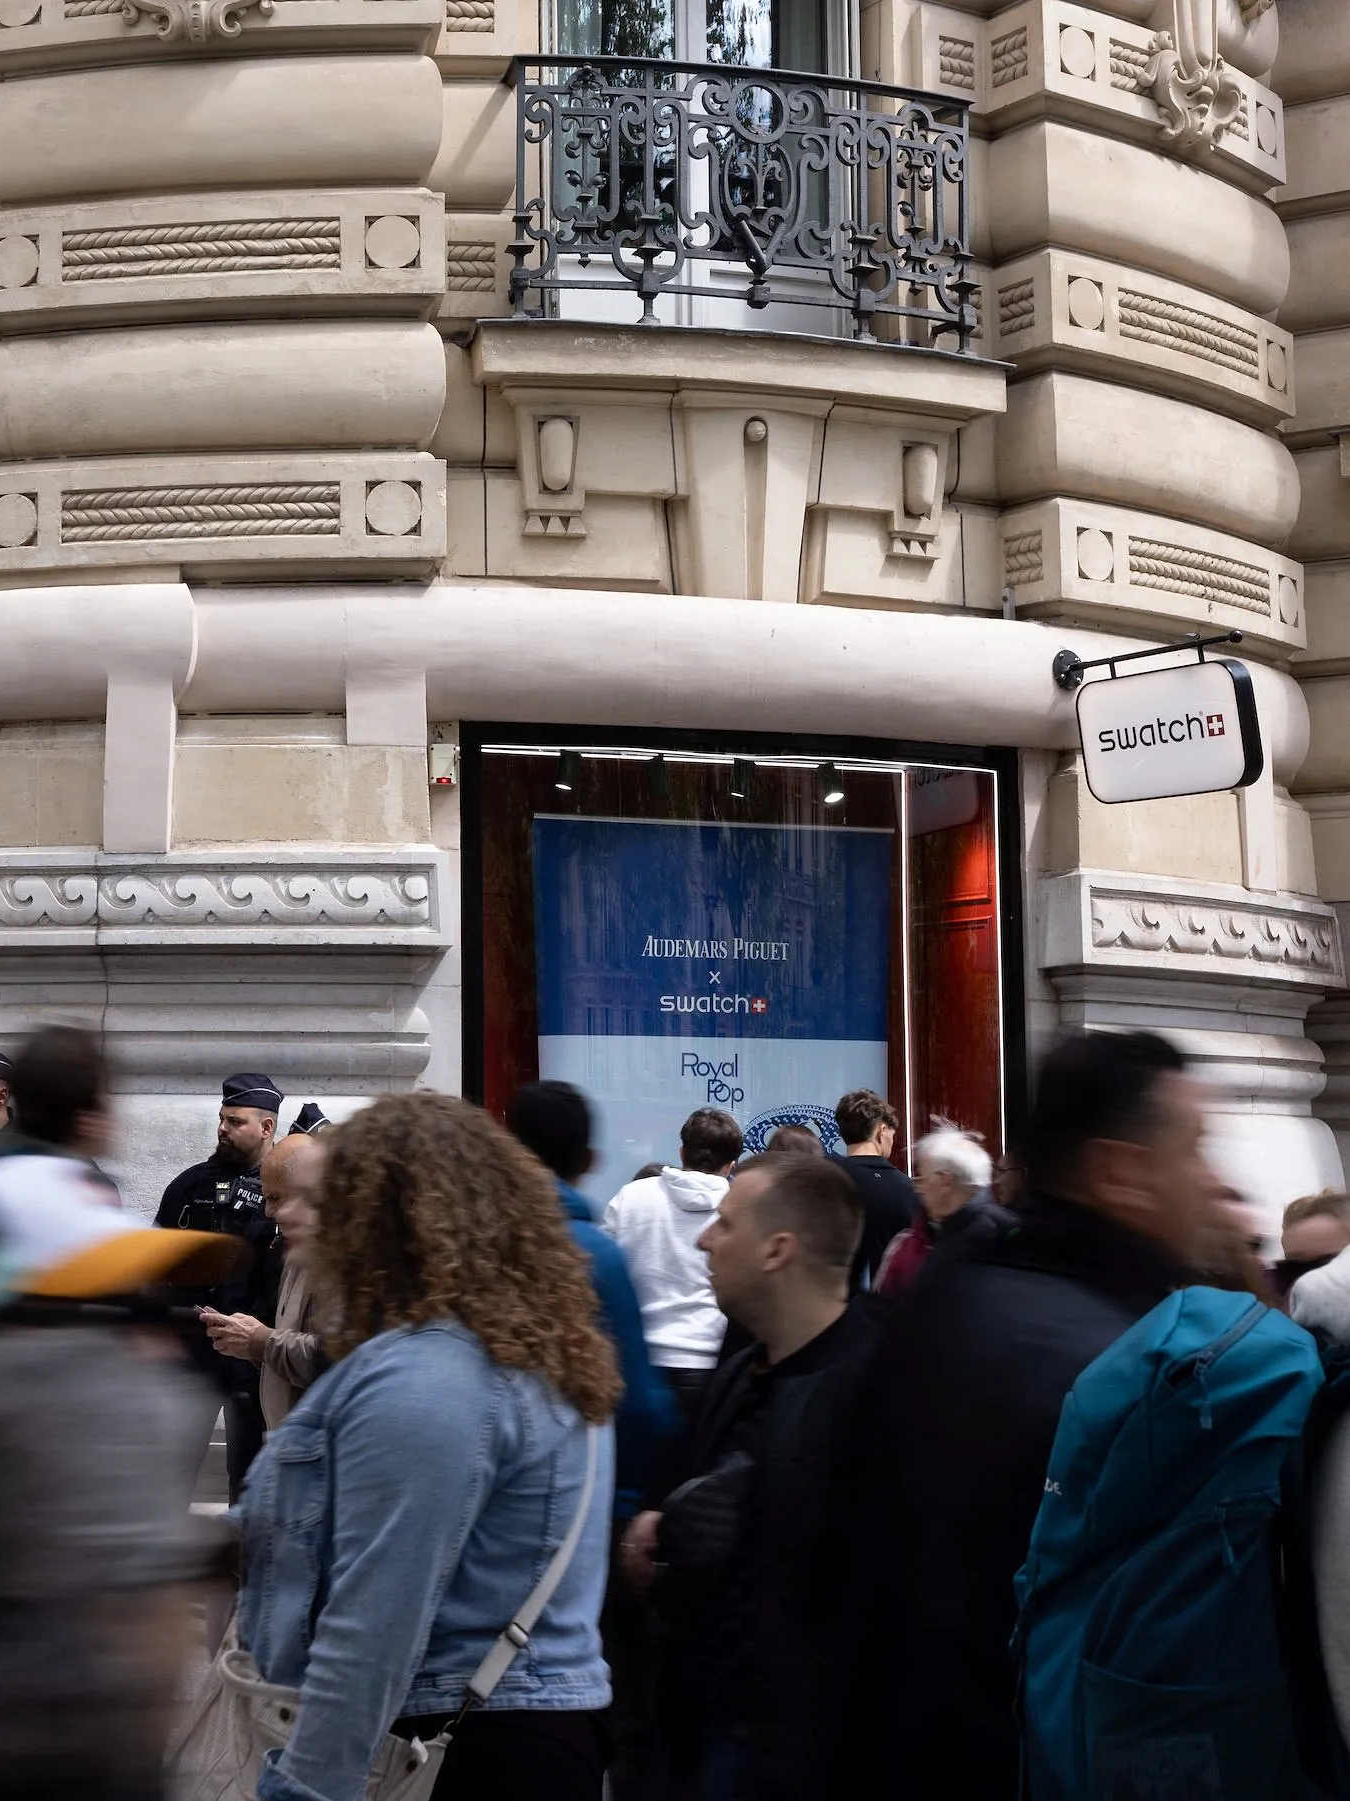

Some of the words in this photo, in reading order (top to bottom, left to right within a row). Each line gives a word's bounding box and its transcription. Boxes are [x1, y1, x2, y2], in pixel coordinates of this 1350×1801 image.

[641, 936, 728, 959] AUDEMARS
[733, 937, 790, 961] PIGUET
[660, 993, 749, 1014] swatch
[681, 1052, 738, 1084] Royal
